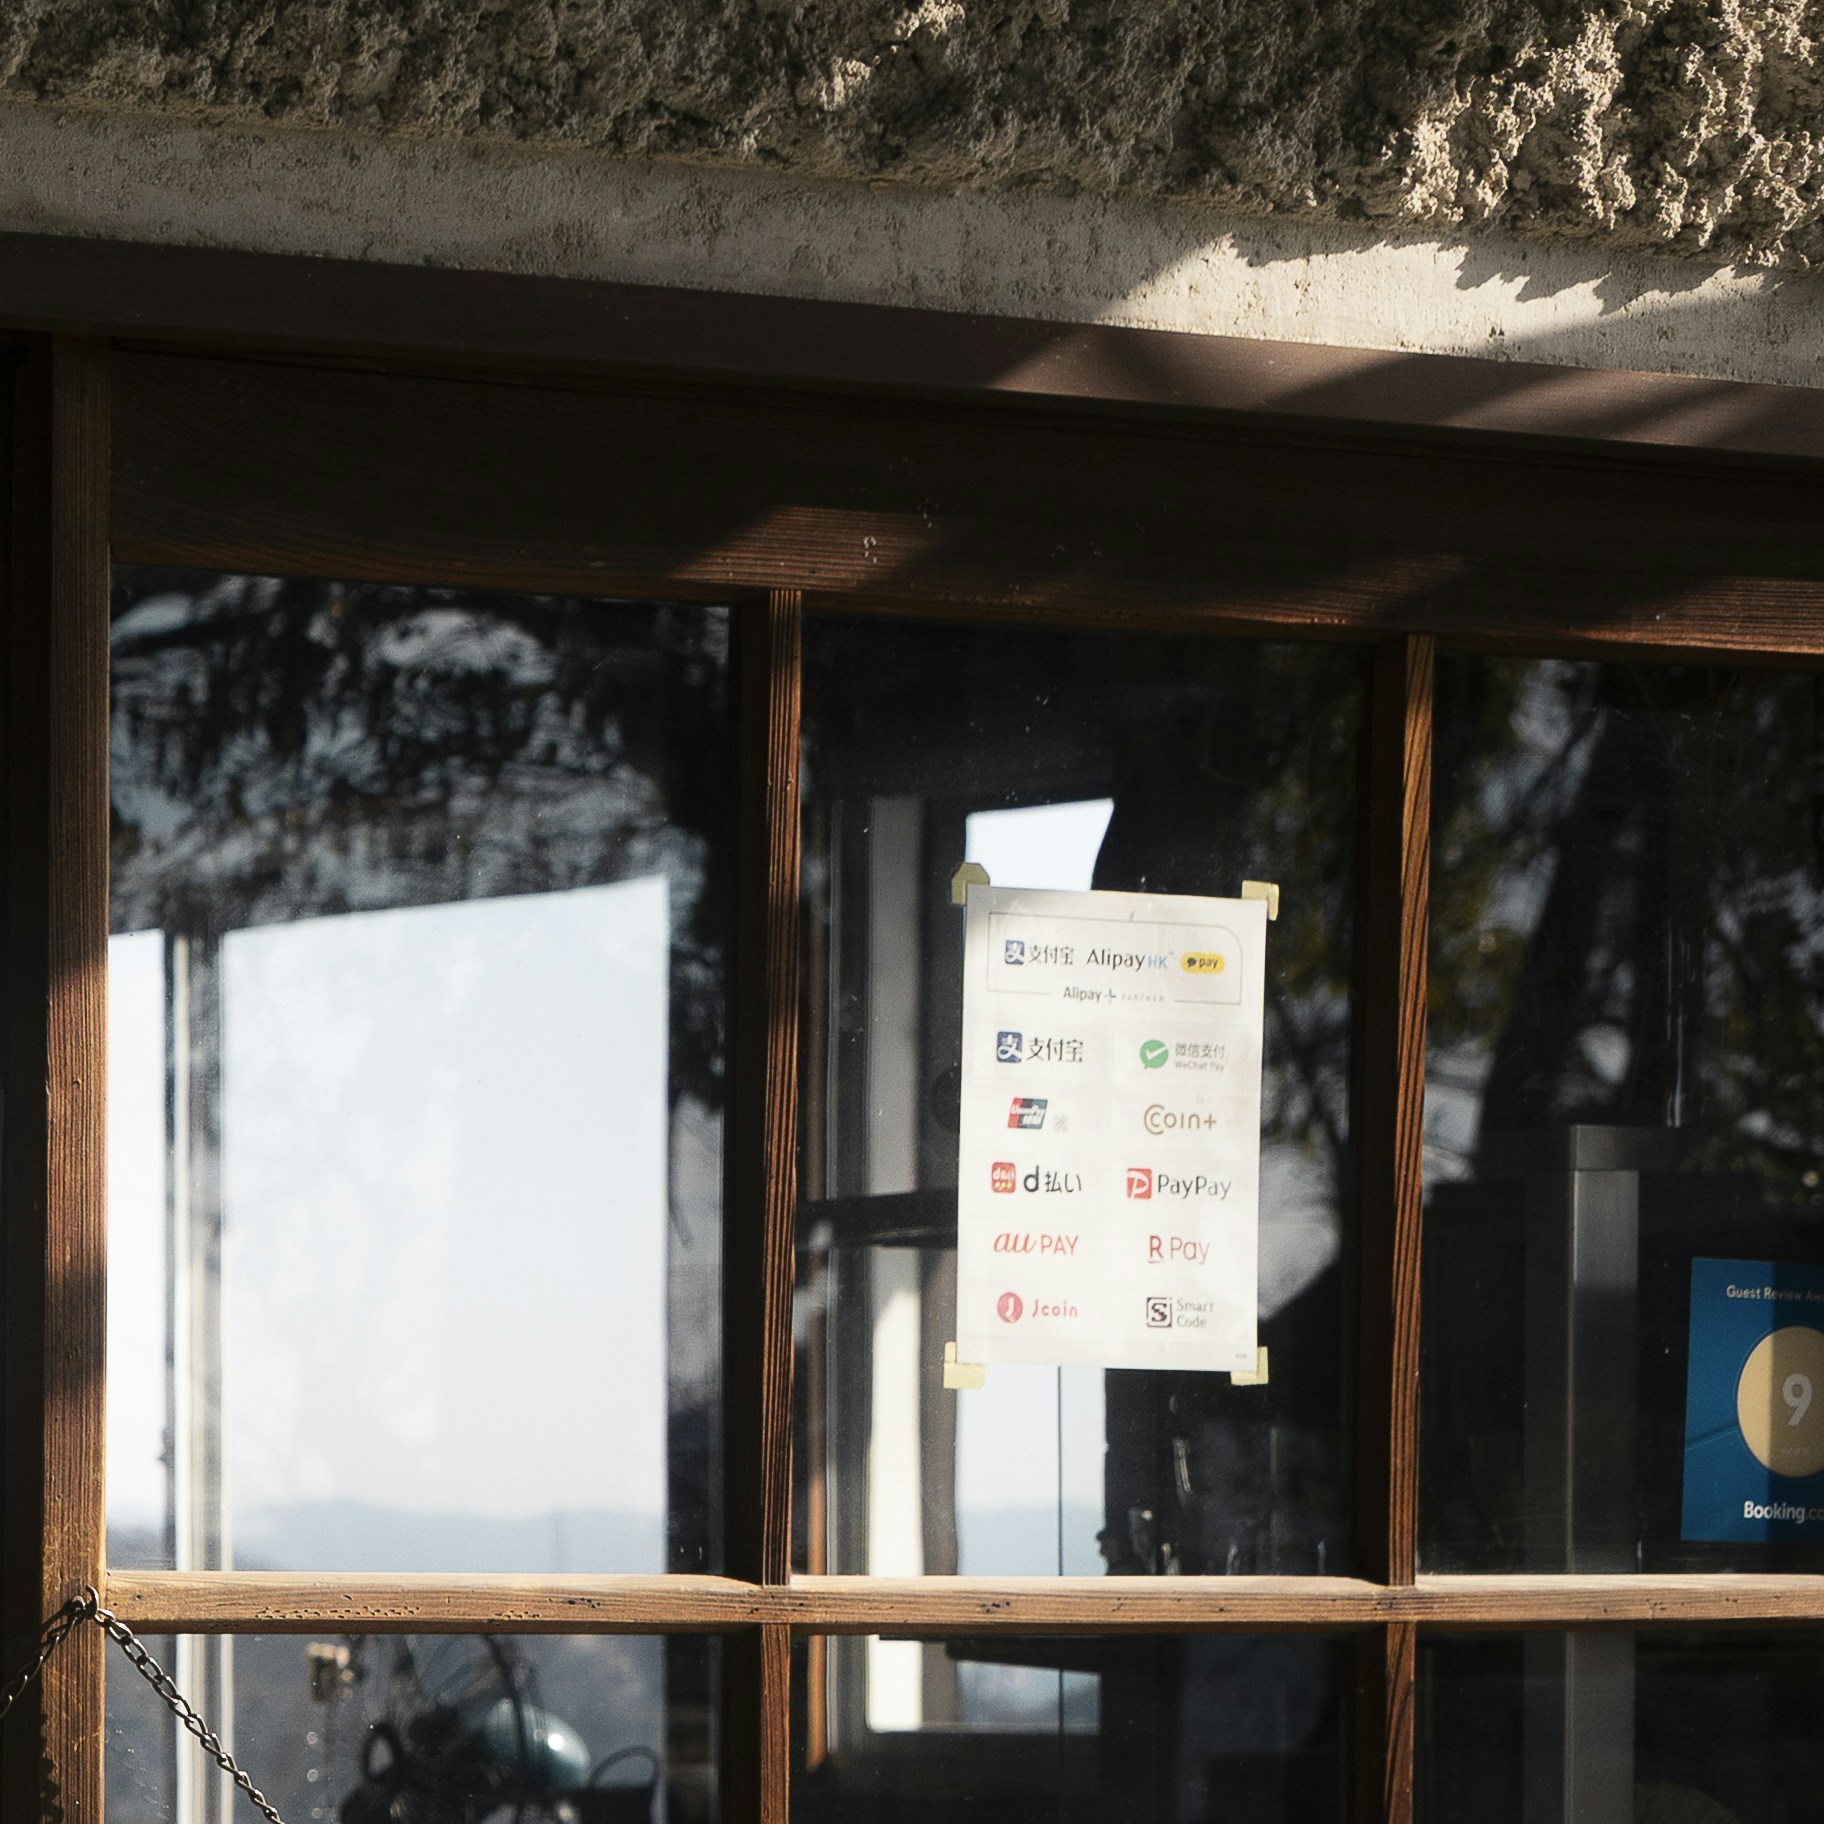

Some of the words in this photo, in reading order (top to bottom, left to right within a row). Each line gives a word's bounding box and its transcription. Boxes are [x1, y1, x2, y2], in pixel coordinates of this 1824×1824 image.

[1199, 957, 1219, 969] pay
[1063, 986, 1102, 1003] Alipay
[1026, 1037, 1084, 1063] 支付宝
[1157, 1173, 1233, 1200] PayPay
[993, 1232, 1038, 1253] au
[1040, 1234, 1079, 1255] PAY
[1170, 1237, 1210, 1265] Pay
[1726, 1284, 1761, 1300] Guest
[1764, 1286, 1802, 1301] Review
[1176, 1299, 1216, 1313] Smart
[1177, 1315, 1208, 1328] Code
[1782, 1373, 1813, 1427] 9
[1743, 1500, 1824, 1524] Booking.co
